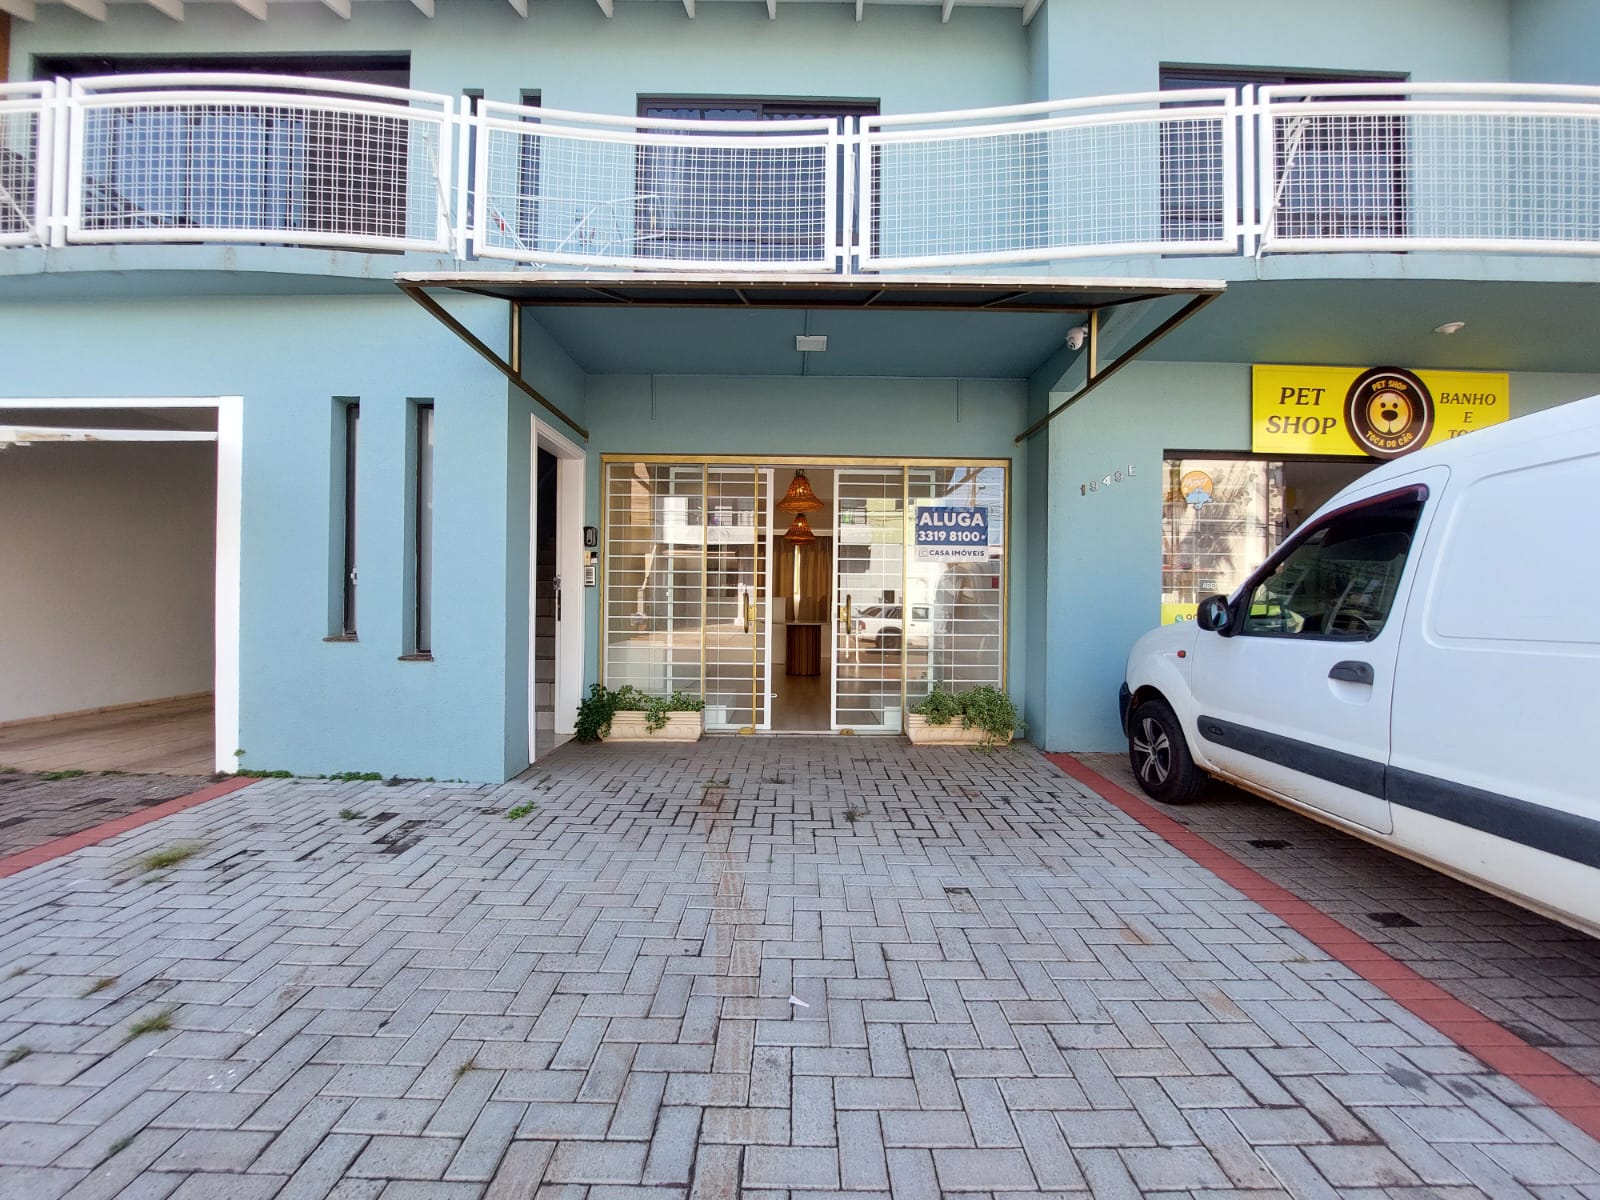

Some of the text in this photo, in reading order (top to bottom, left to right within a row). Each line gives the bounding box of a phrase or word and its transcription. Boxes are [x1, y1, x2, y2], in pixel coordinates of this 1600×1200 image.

[1371, 380, 1407, 391] PET SHOP
[1279, 387, 1325, 405] PET
[1440, 392, 1496, 405] BANHO
[1464, 411, 1473, 423] E
[1266, 415, 1337, 434] SHOP
[1366, 430, 1413, 448] TOCA DO CÃO
[919, 512, 984, 527] ALUGA
[918, 530, 980, 541] 3319 8100
